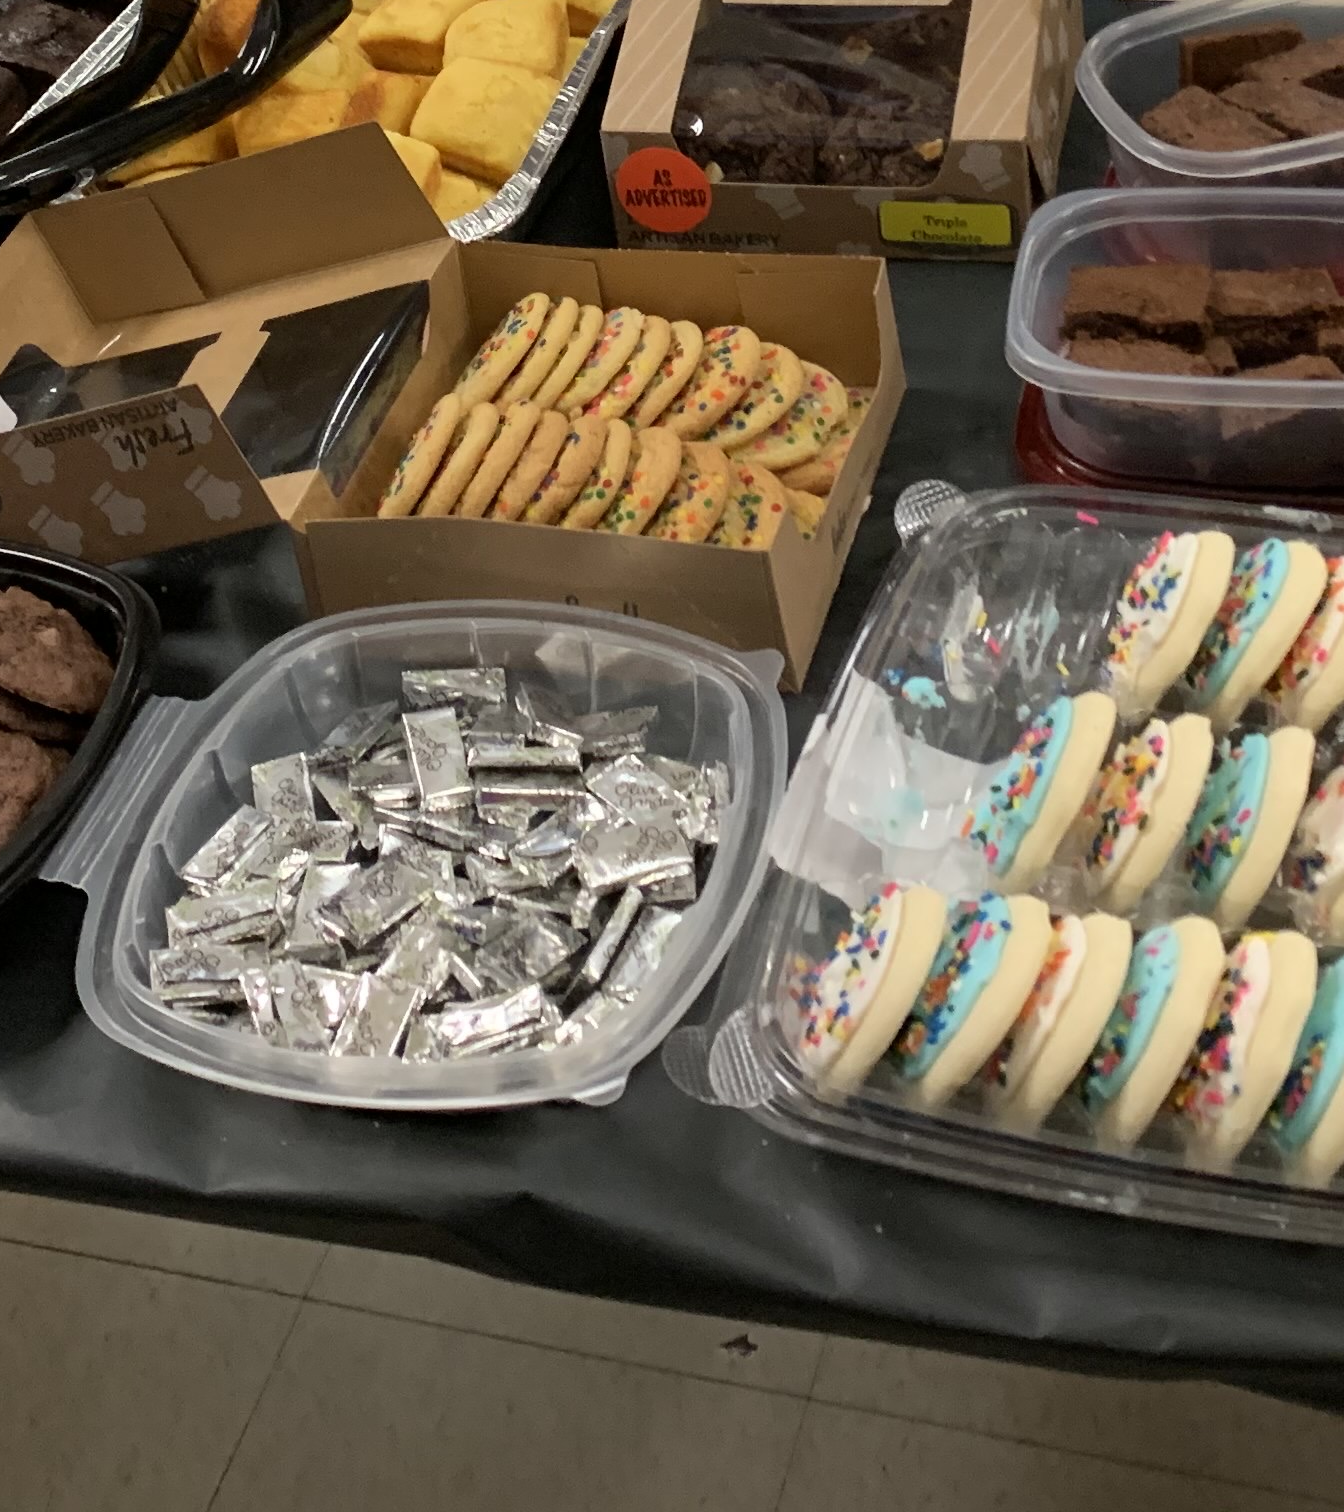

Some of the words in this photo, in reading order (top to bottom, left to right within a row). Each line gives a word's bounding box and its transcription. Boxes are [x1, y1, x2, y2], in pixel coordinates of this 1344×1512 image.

[653, 169, 672, 186] AS
[625, 188, 706, 208] ADVERTISED
[100, 396, 178, 431] ARTISAN
[31, 419, 99, 448] BAKERY
[113, 416, 195, 468] Fresh
